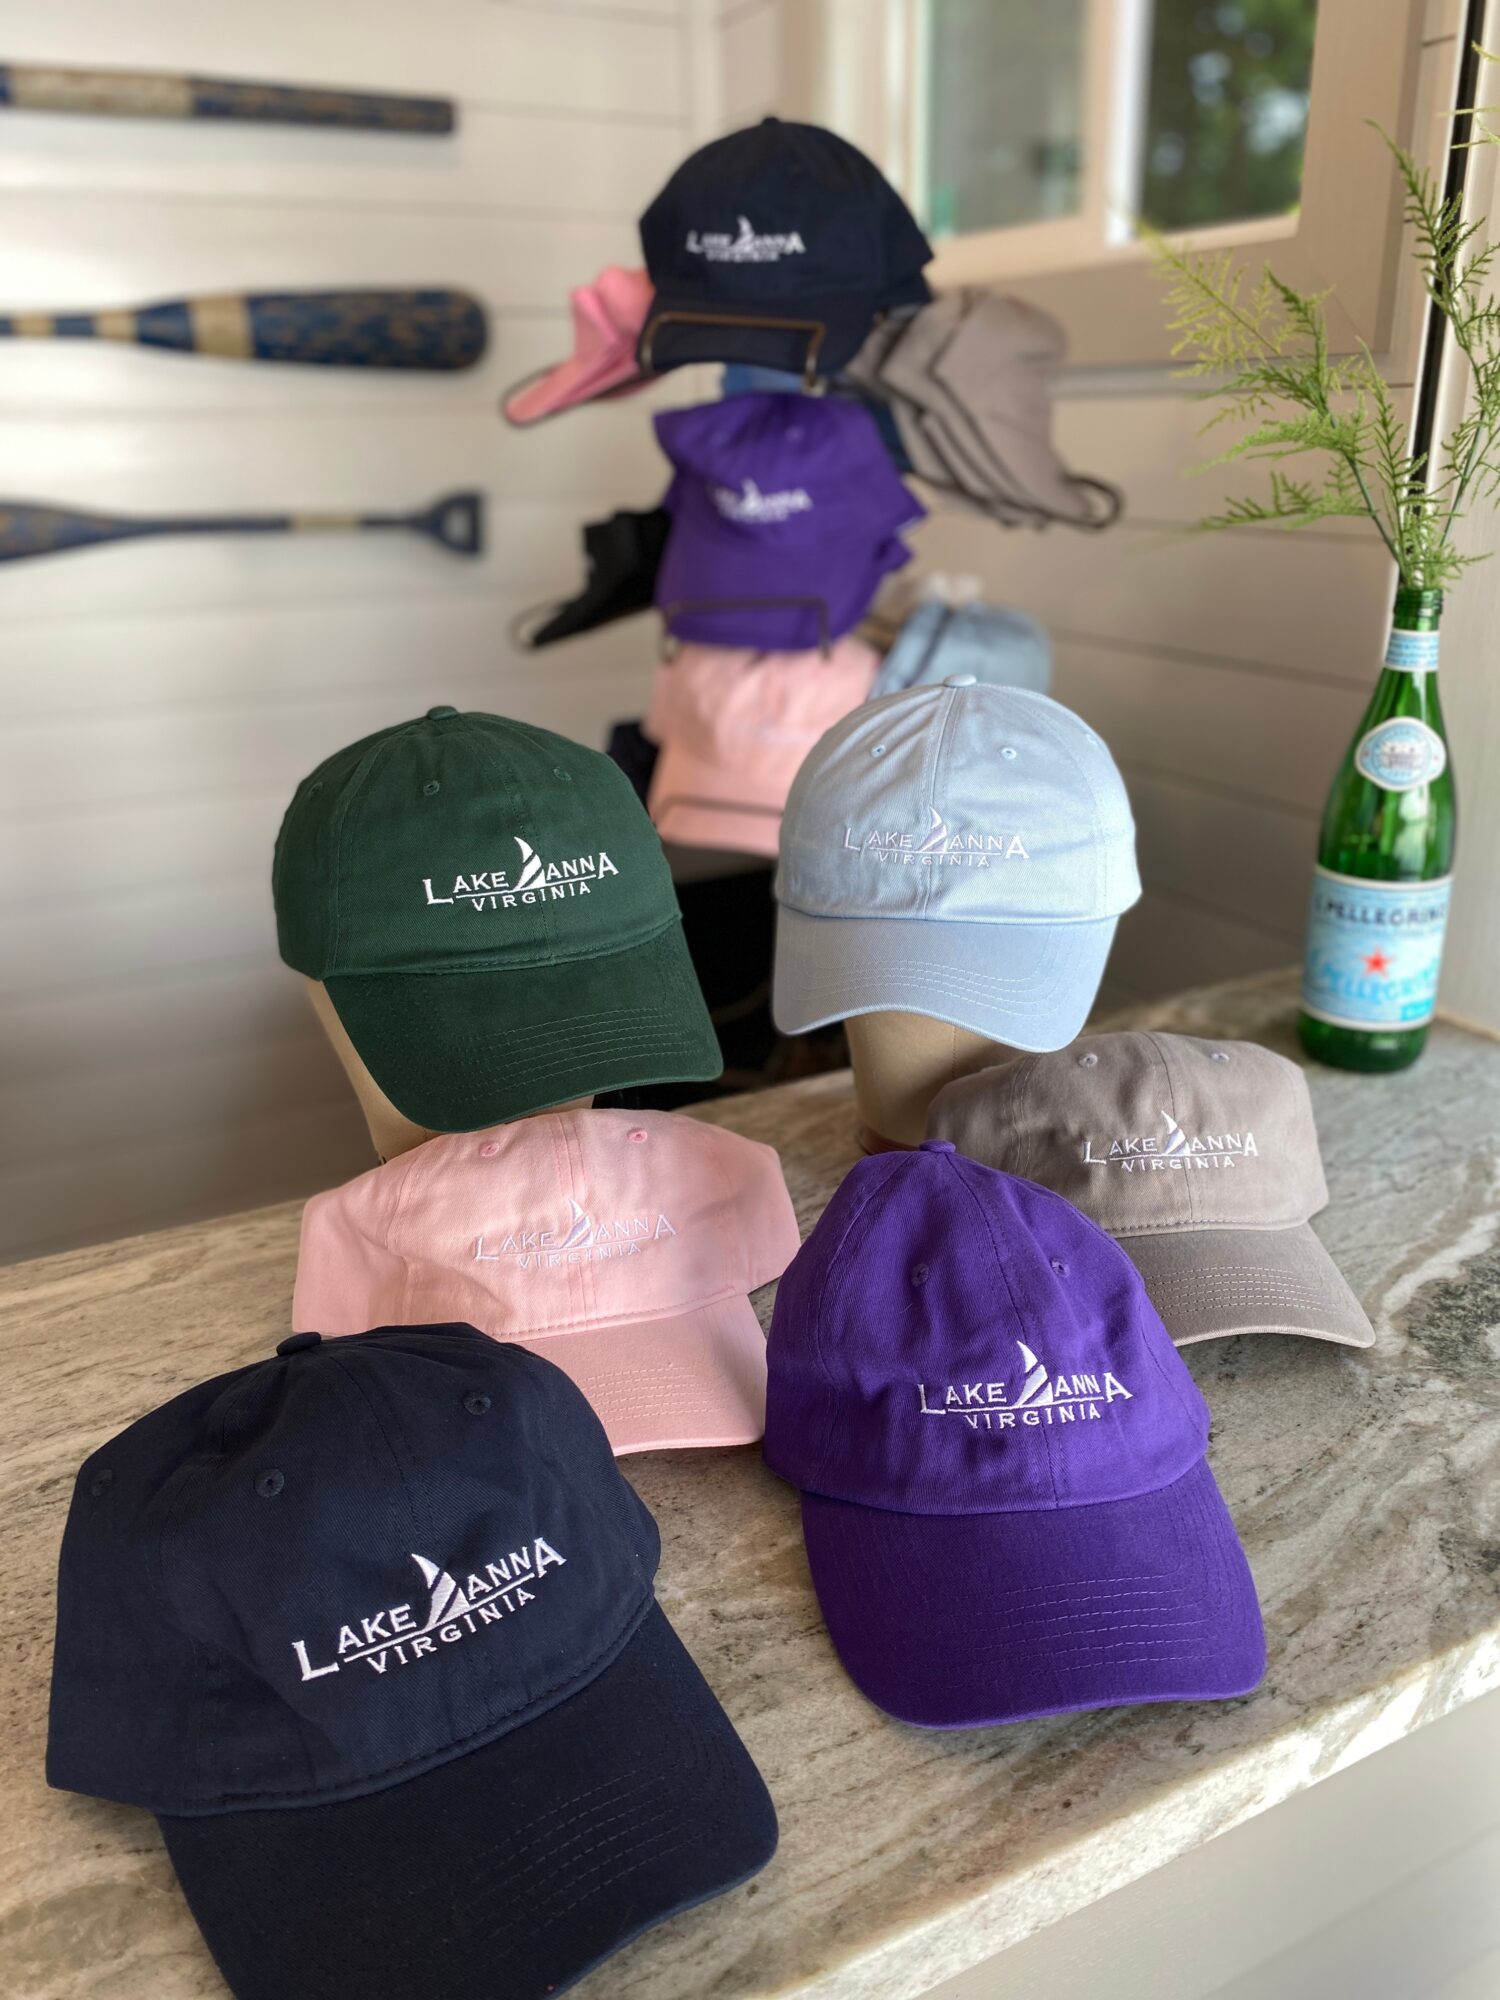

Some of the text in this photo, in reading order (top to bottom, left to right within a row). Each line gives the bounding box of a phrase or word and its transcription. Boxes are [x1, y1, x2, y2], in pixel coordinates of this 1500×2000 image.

[842, 827, 1030, 860] LAKE ANNA
[877, 851, 990, 868] VIRGINIA
[422, 852, 619, 905] LAKE ANNA
[471, 881, 592, 912] VIRGINIA
[1083, 1132, 1259, 1165] LAKE ANNA
[1121, 1155, 1236, 1173] VIRGINIA
[475, 1213, 677, 1262] LAKE ANNA
[519, 1242, 641, 1270] VIRGINIA
[917, 1372, 1134, 1415] LAKE ANNA
[964, 1403, 1102, 1429] VIRGINIA
[291, 1537, 568, 1682] LAKE ANNA
[366, 1586, 536, 1675] VIRGINIA
